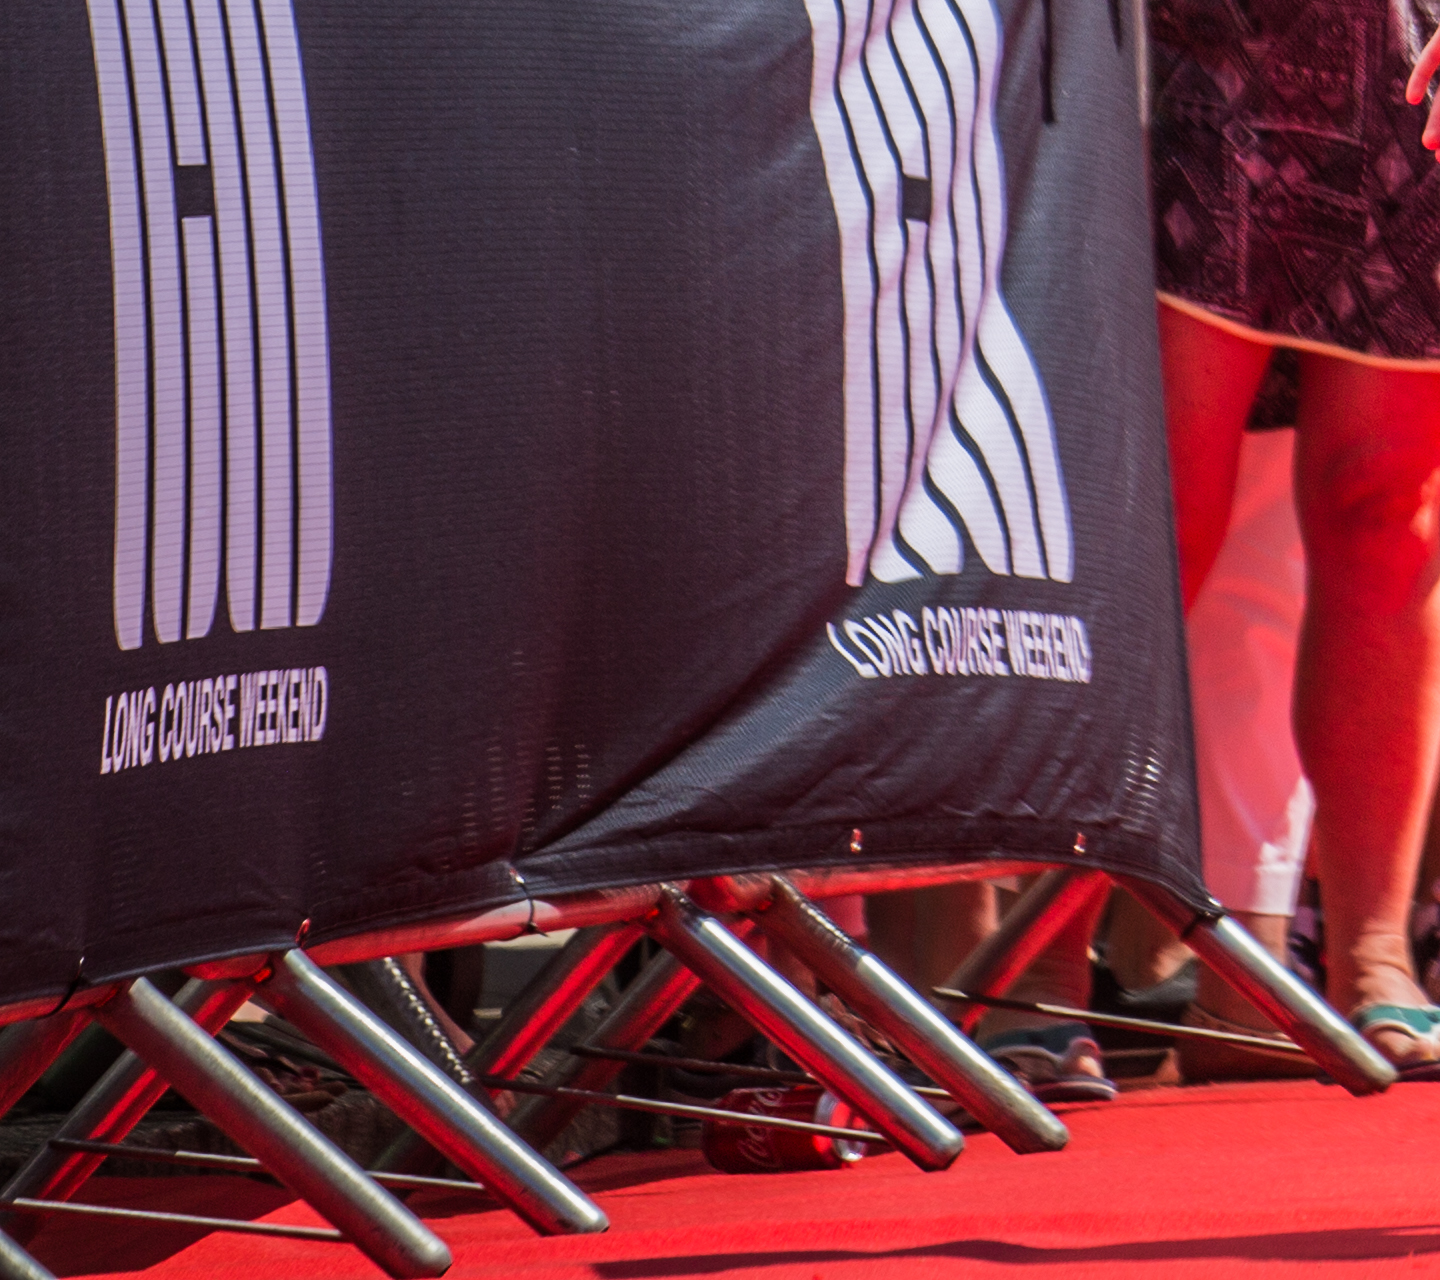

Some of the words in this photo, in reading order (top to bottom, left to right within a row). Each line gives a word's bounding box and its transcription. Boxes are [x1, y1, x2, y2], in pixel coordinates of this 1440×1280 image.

[826, 608, 929, 679] LONG
[921, 605, 1011, 677] COURSE
[1001, 608, 1094, 684] WEEKEND
[100, 686, 157, 775] LONG
[158, 673, 239, 763] COURSE
[239, 665, 329, 749] WEEKEND
